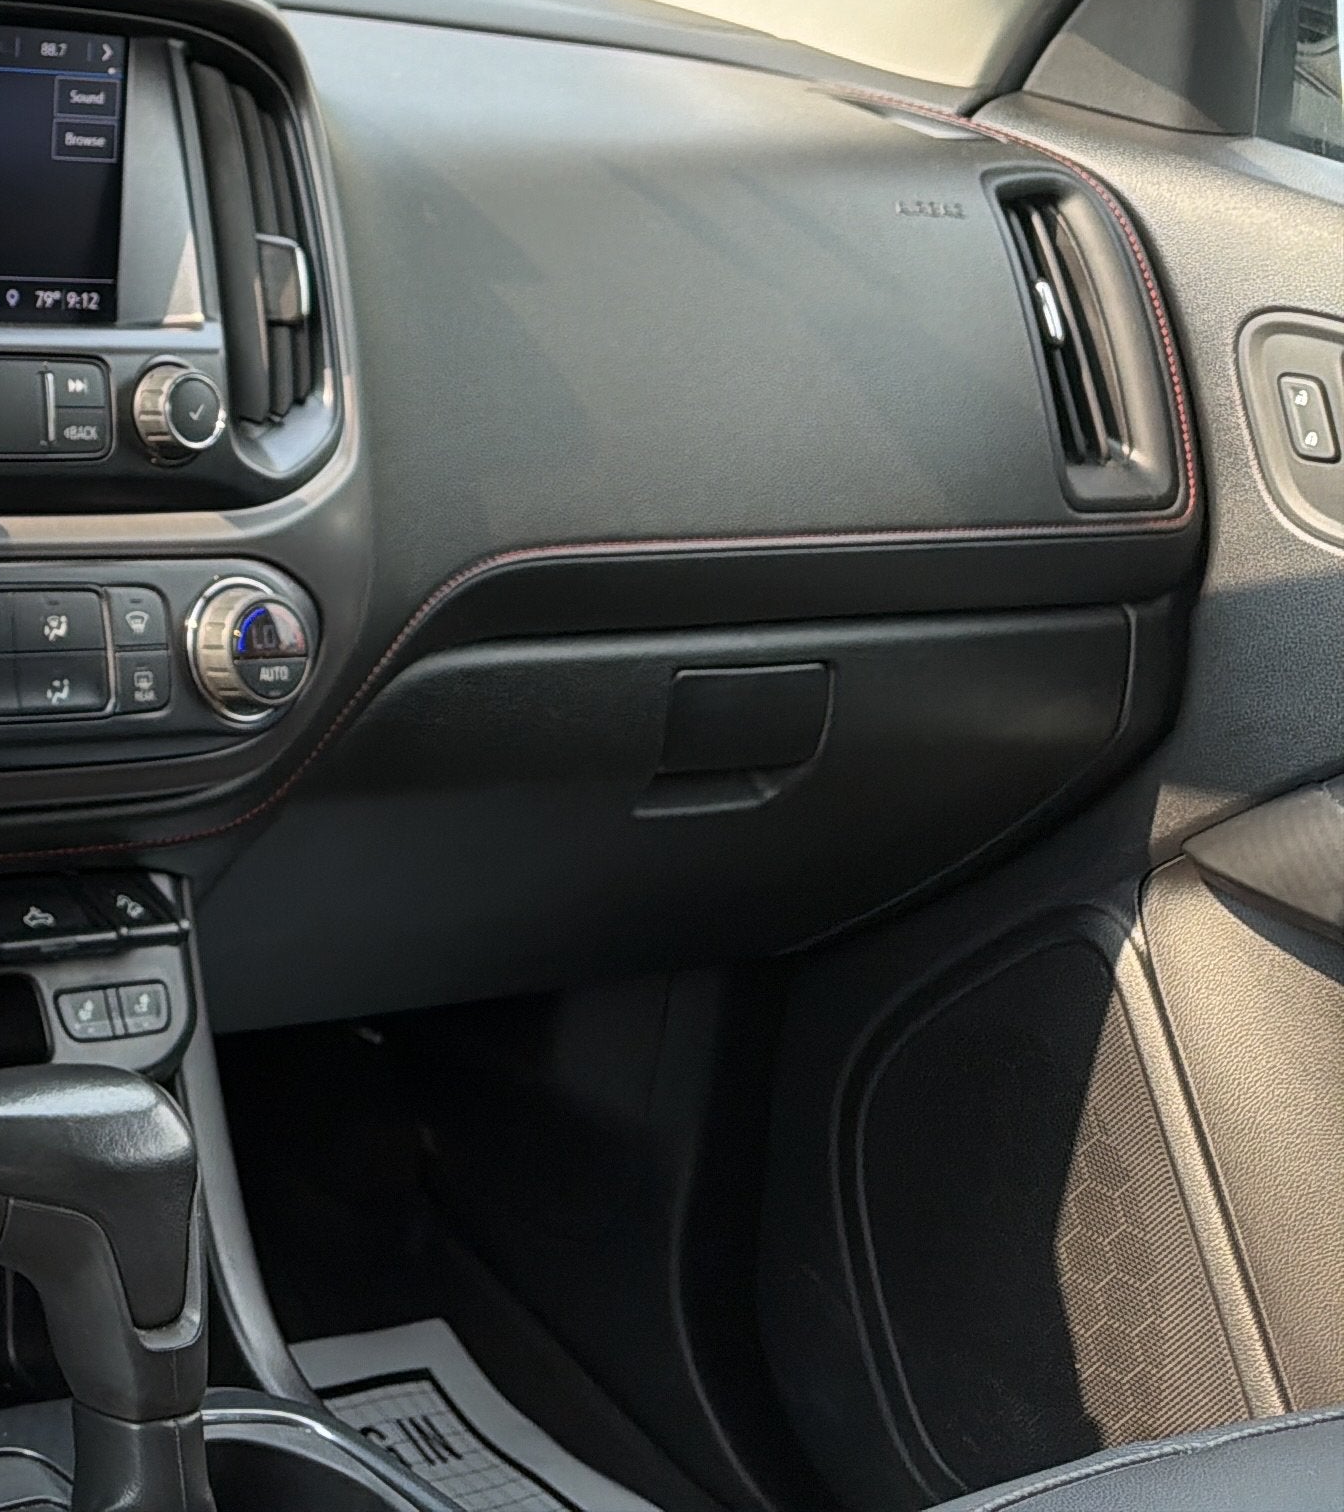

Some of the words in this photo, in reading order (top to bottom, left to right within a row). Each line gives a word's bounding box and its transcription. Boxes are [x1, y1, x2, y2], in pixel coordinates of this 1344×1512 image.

[70, 90, 106, 105] Sound
[65, 132, 106, 148] Browse
[66, 291, 100, 310] 9:12
[69, 425, 99, 441] BACK
[259, 665, 289, 682] AUTO
[134, 687, 156, 702] REAR
